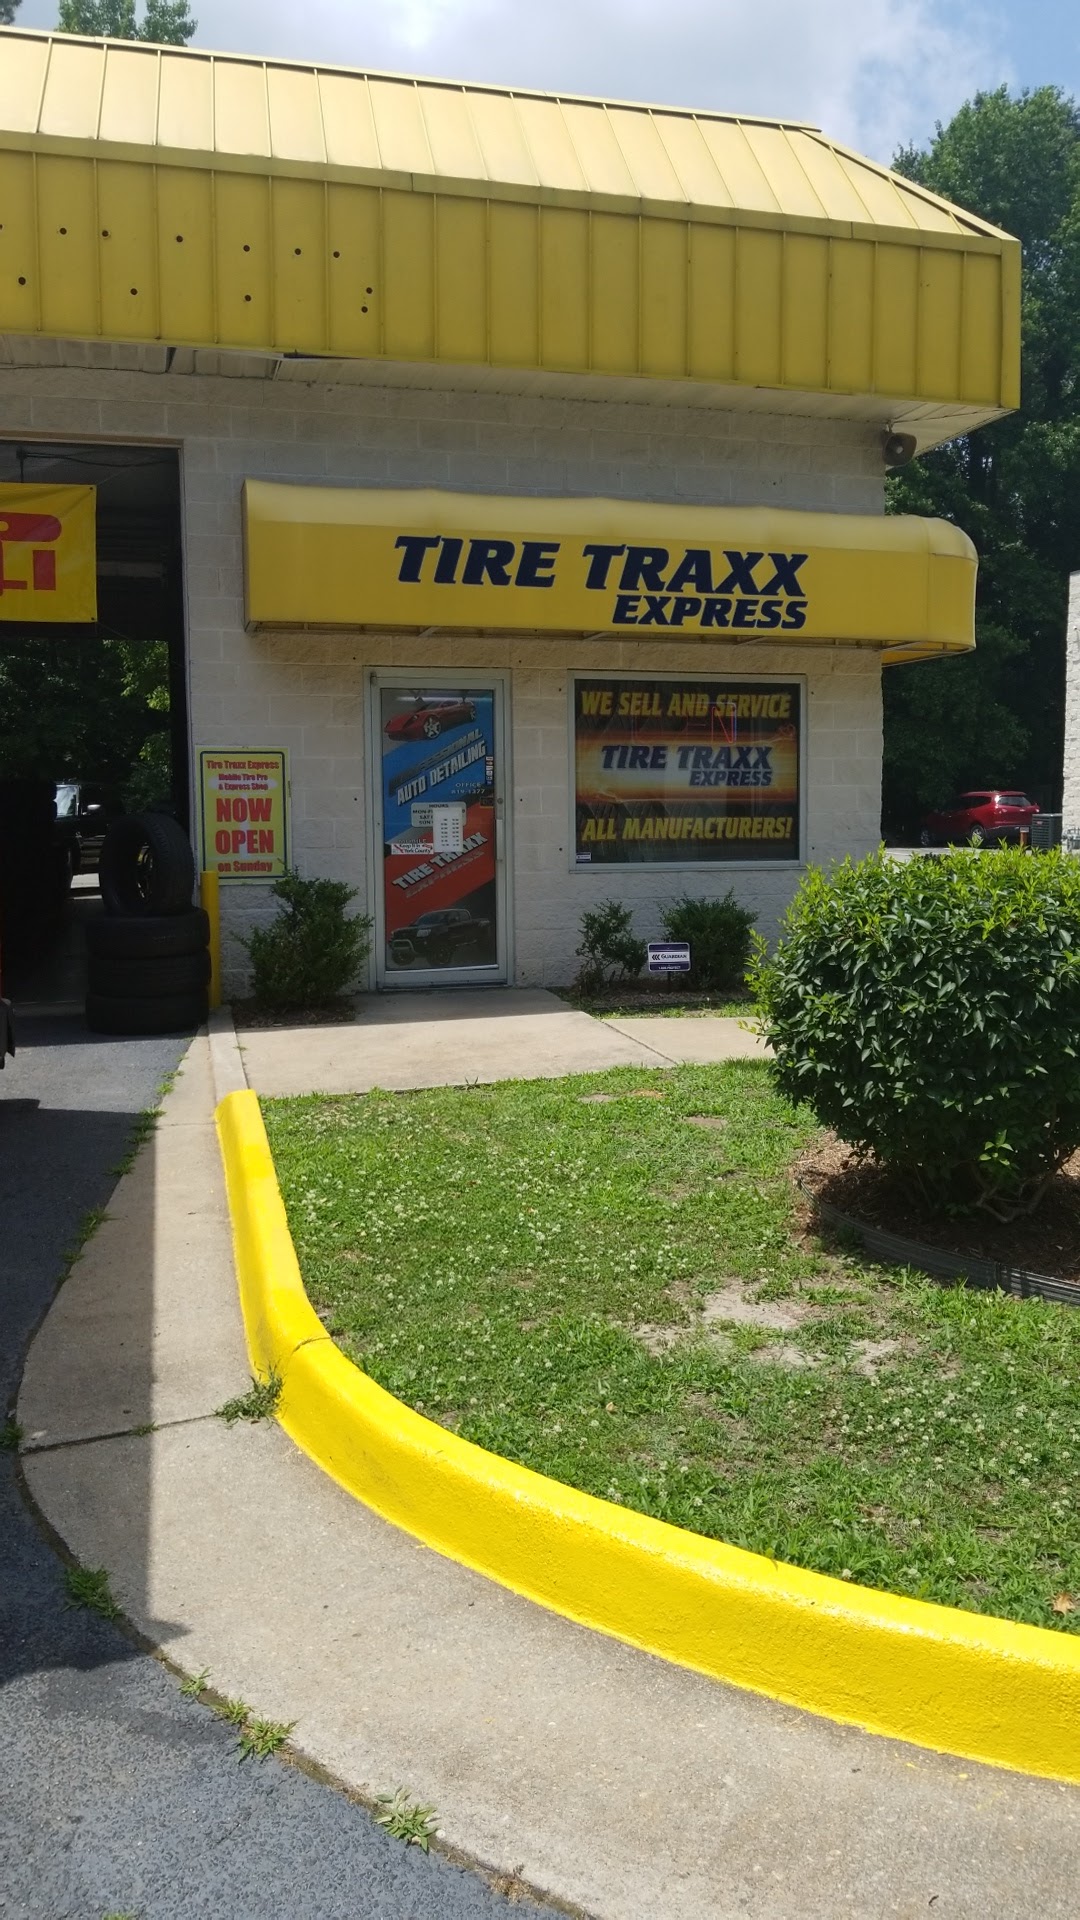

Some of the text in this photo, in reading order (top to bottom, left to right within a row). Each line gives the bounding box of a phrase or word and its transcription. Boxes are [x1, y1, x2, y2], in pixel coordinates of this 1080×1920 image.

[394, 535, 809, 597] TIRE TRAXX
[612, 594, 808, 629] EXPRESS
[581, 691, 792, 718] WE SELL AND SERVICE
[206, 760, 280, 771] Tire Traxx Express
[389, 728, 483, 797] ESSIONAL
[601, 745, 773, 770] TIRE TRAXX
[218, 773, 241, 781] Mobile
[242, 773, 256, 781] Tire
[397, 776, 427, 806] AUTO
[430, 740, 486, 787] DETAILING
[689, 771, 773, 787] EXPRESS
[224, 783, 250, 791] Express
[251, 782, 269, 791] Shop
[216, 797, 273, 823] NOW
[215, 829, 274, 855] OPEN
[581, 816, 793, 842] ALL MANUFACTURERS!
[217, 861, 273, 873] on Sunday
[391, 862, 435, 890] TIRE
